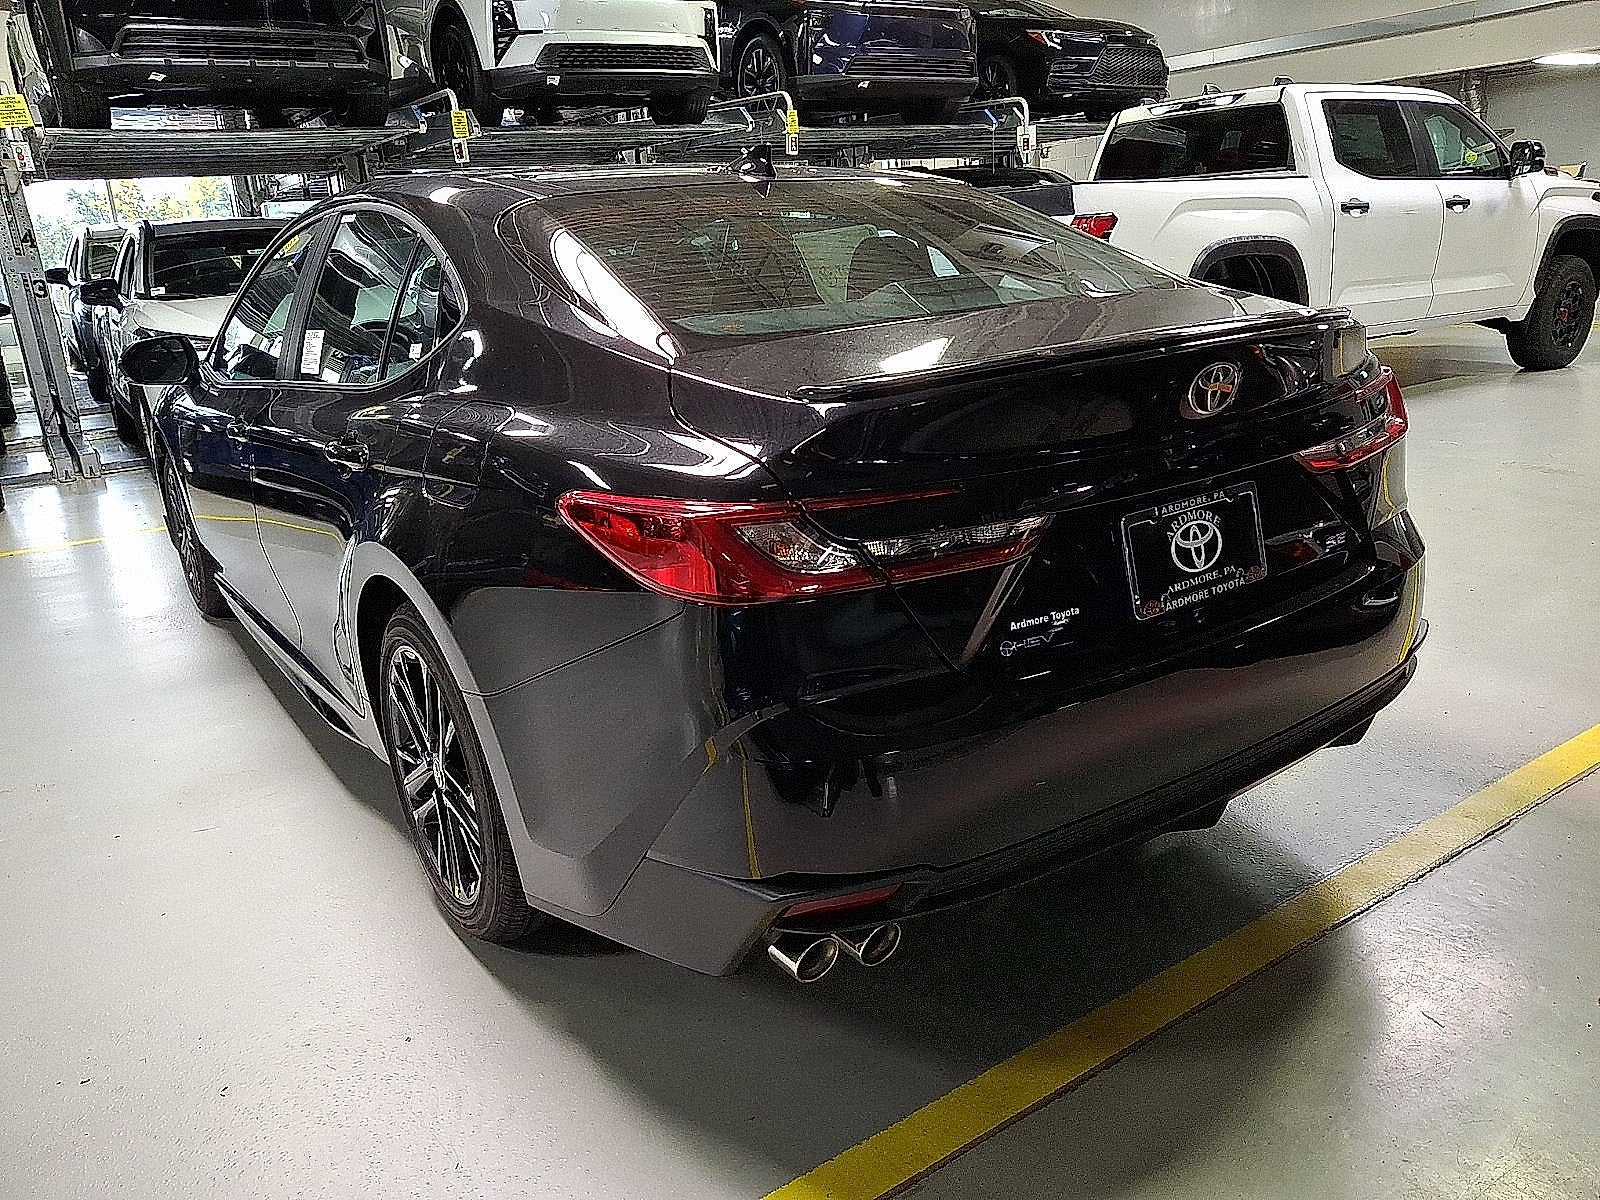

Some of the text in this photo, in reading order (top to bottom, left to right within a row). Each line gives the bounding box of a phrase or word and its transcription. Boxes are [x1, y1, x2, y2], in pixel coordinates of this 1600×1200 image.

[20, 228, 38, 249] 4
[33, 278, 48, 299] 3
[1161, 490, 1226, 515] ARDMORE, PA
[1166, 509, 1222, 542] ARDMORE
[1168, 565, 1237, 594] ARDMORE, PA
[1165, 577, 1246, 612] ARDMORE TOYOTA
[1010, 607, 1080, 632] Ardmore Toyota
